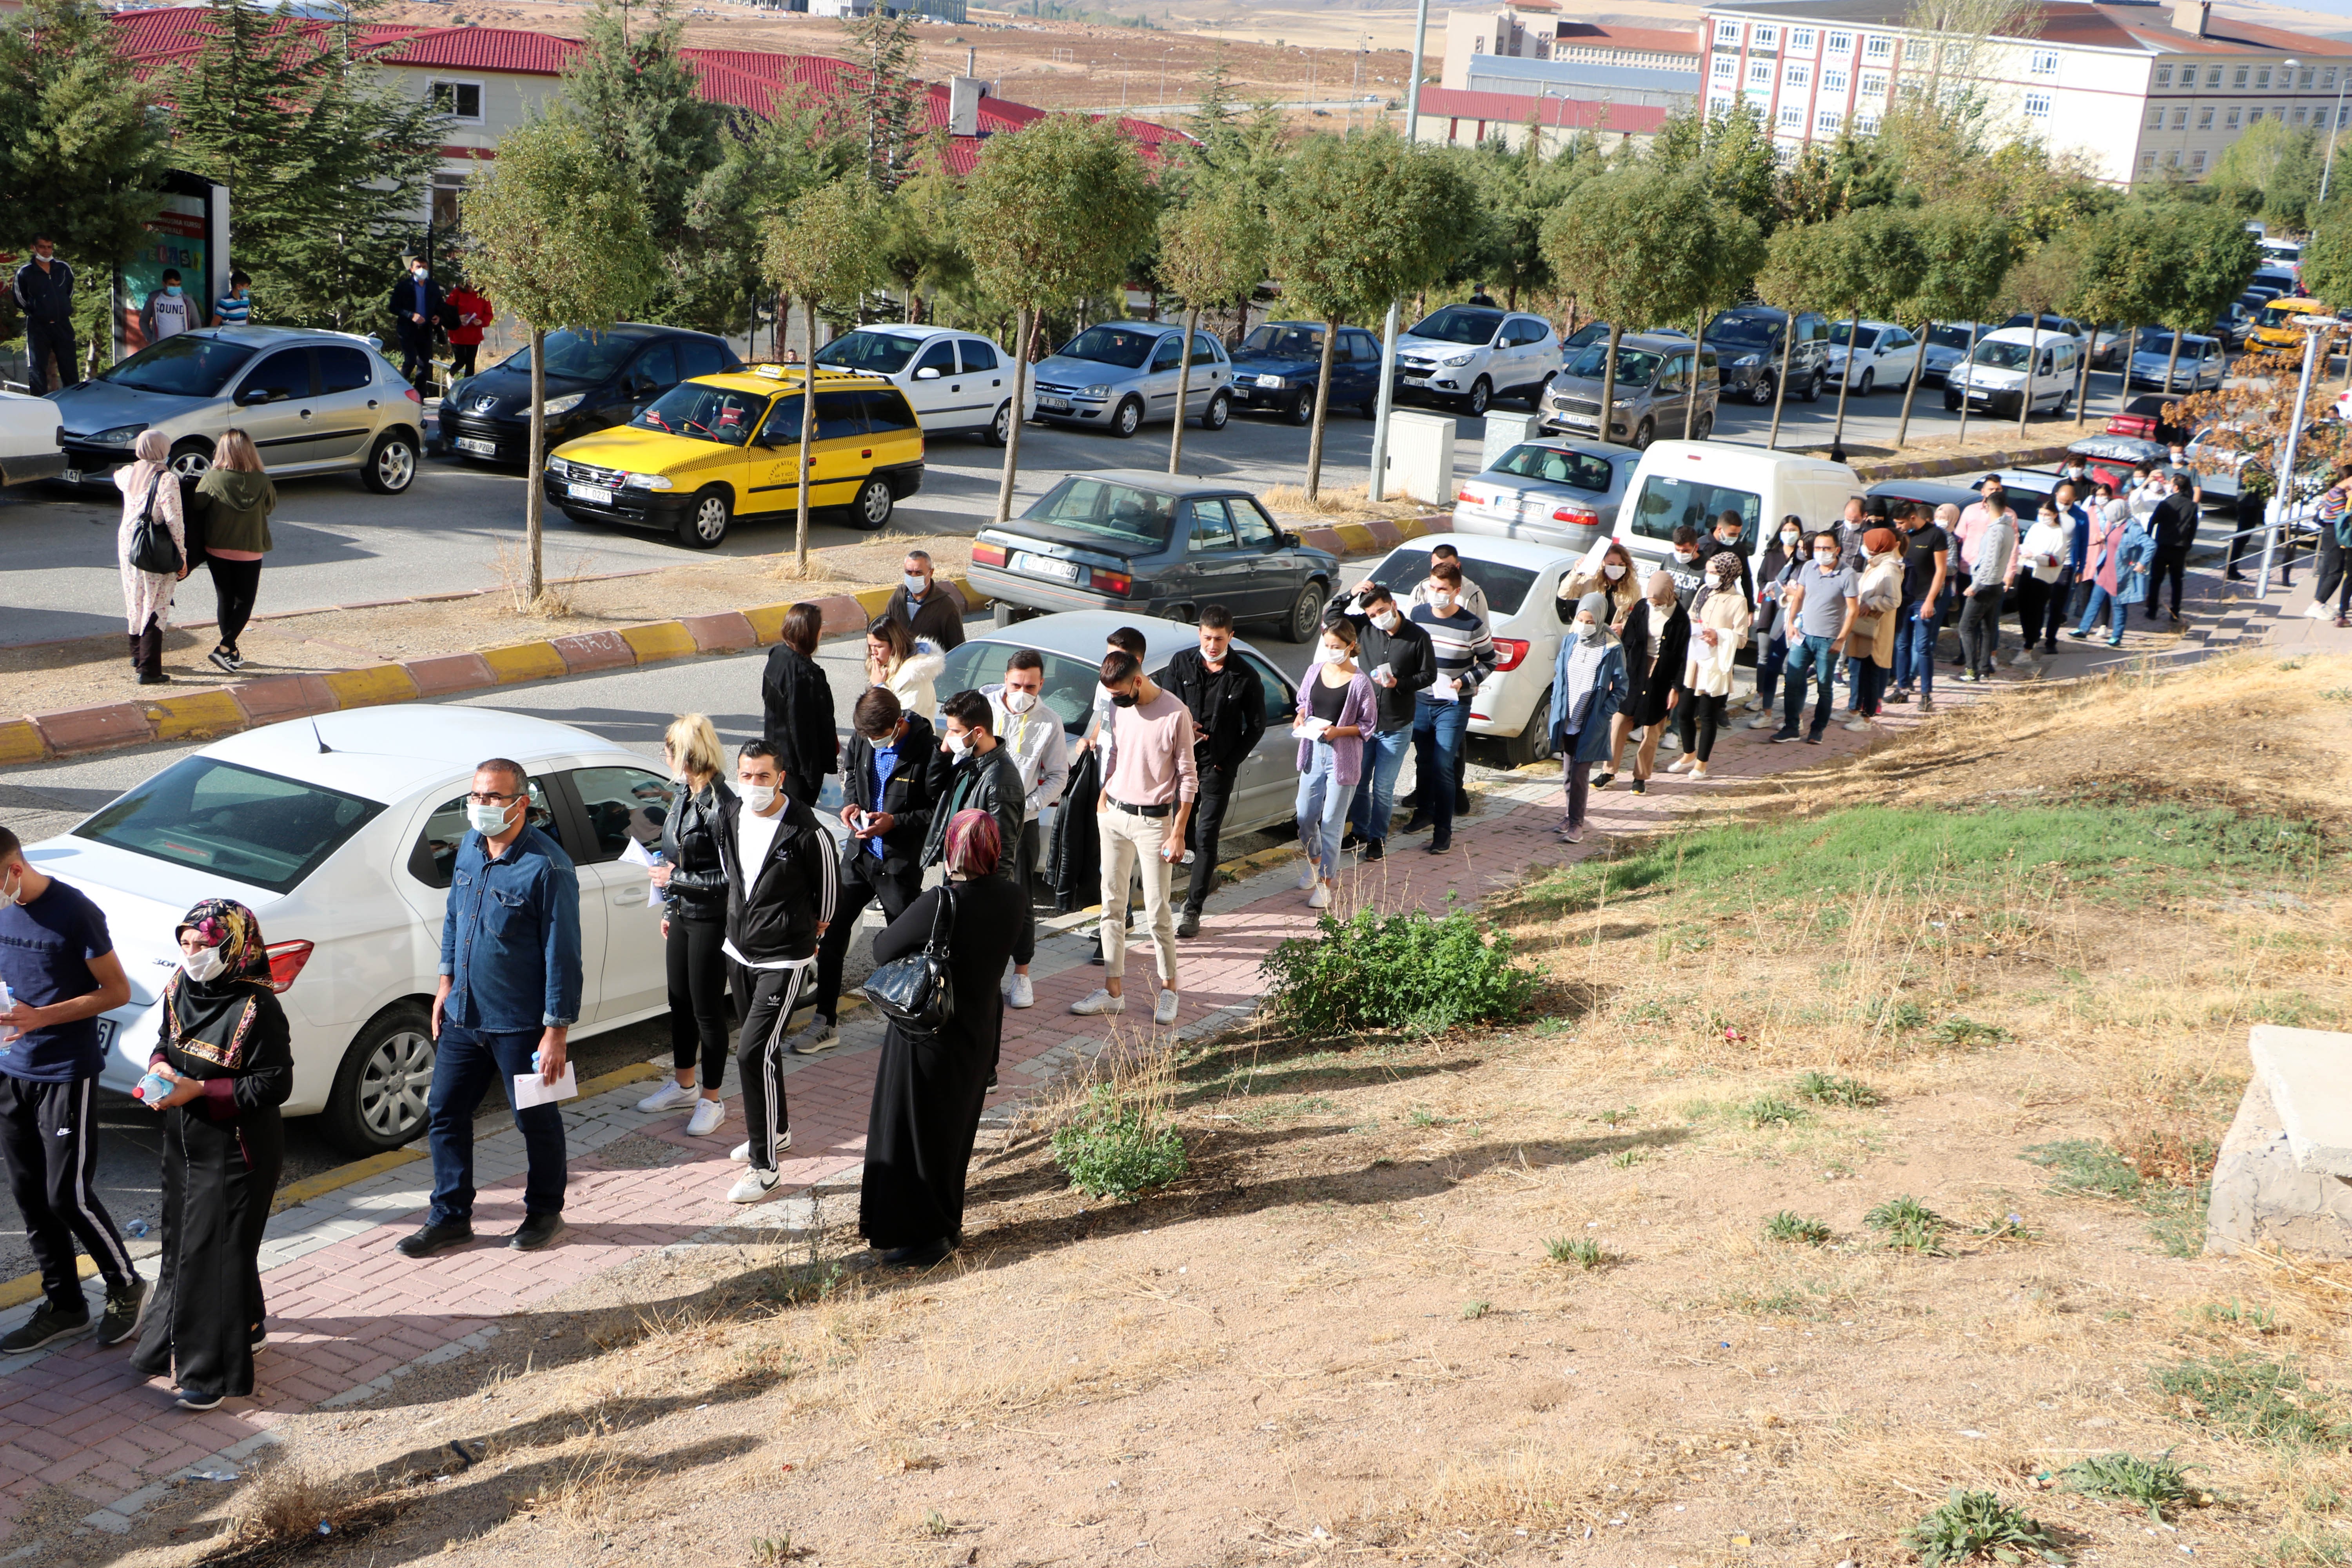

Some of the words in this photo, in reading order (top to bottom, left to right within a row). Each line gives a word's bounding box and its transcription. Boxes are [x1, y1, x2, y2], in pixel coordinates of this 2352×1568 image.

[458, 439, 466, 448] 34
[478, 443, 494, 453] 7205
[65, 470, 78, 481] 147
[572, 486, 581, 495] 66
[584, 488, 588, 496] T
[592, 489, 610, 501] 0221
[1527, 503, 1541, 512] 919
[1060, 565, 1076, 577] 040
